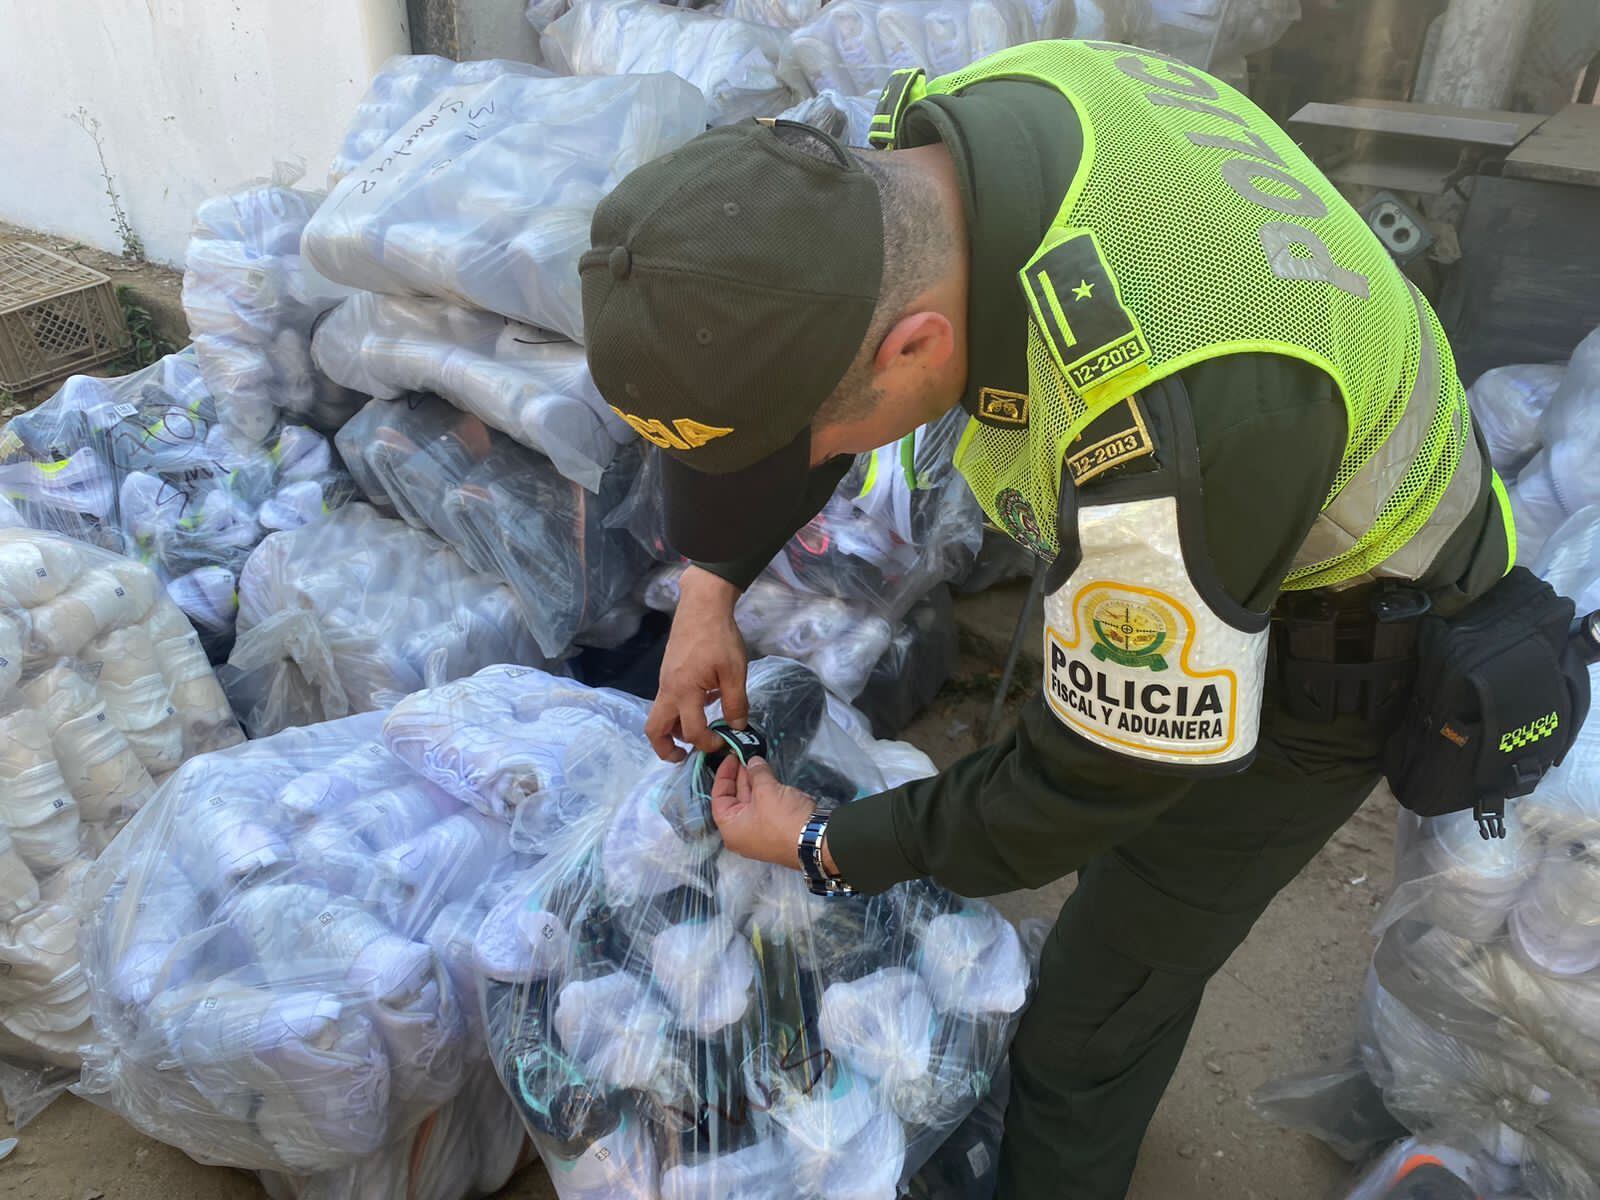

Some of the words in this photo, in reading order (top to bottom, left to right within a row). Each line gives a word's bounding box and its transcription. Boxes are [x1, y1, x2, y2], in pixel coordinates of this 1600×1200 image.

[1073, 340, 1140, 384] 12-2013
[1073, 435, 1138, 475] 12-2013
[1051, 641, 1224, 718] POLICIA
[1051, 675, 1097, 720] FISCAL
[1101, 705, 1113, 725] Y
[1117, 712, 1223, 740] ADUANERA
[1501, 711, 1558, 744] POLICIA
